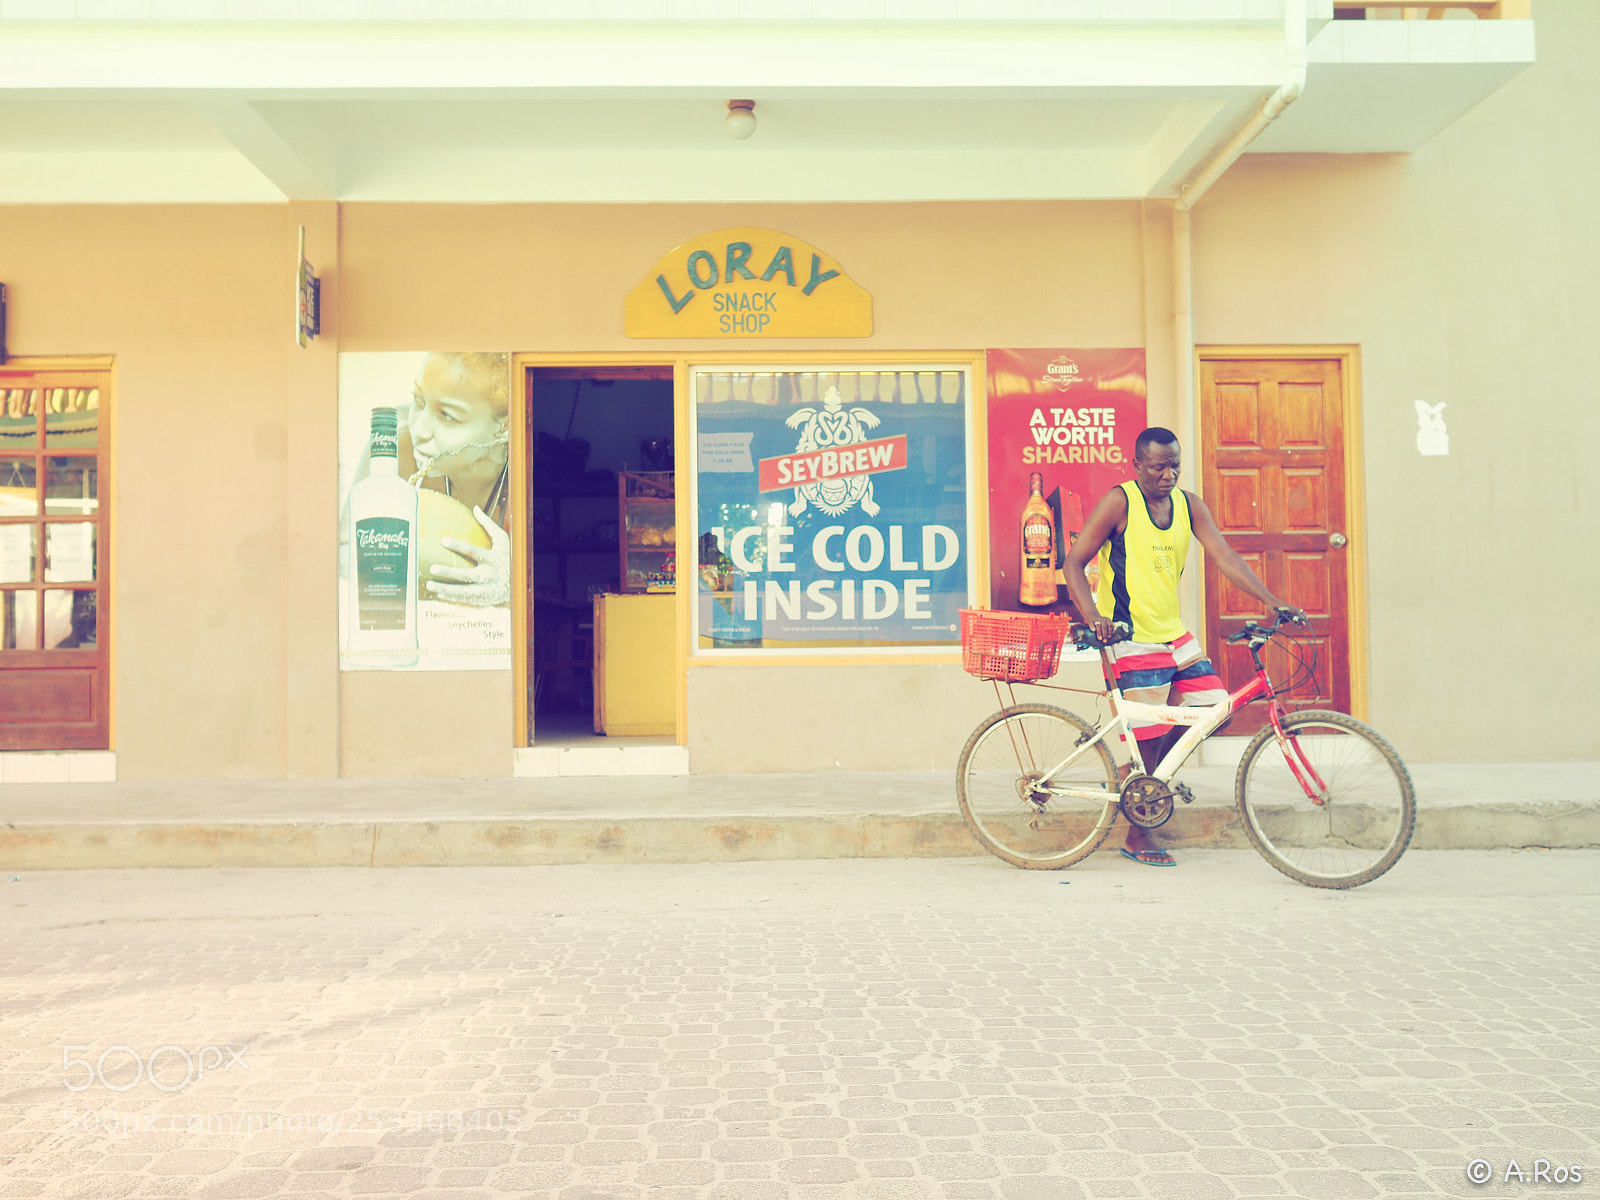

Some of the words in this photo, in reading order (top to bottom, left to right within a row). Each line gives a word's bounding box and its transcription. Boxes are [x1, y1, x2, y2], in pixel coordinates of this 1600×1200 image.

[655, 241, 840, 315] LORAY
[713, 292, 777, 312] SNACK
[719, 314, 770, 333] SHOP
[1029, 408, 1047, 426] A
[1050, 408, 1116, 426] TASTE
[1031, 427, 1114, 445] WORTH
[1022, 446, 1128, 464] SHARING.
[356, 528, 409, 548] Takamaka
[812, 524, 960, 572] COLD
[743, 578, 932, 622] INSIDE
[447, 619, 493, 631] Seychelles
[483, 630, 505, 640] Style
